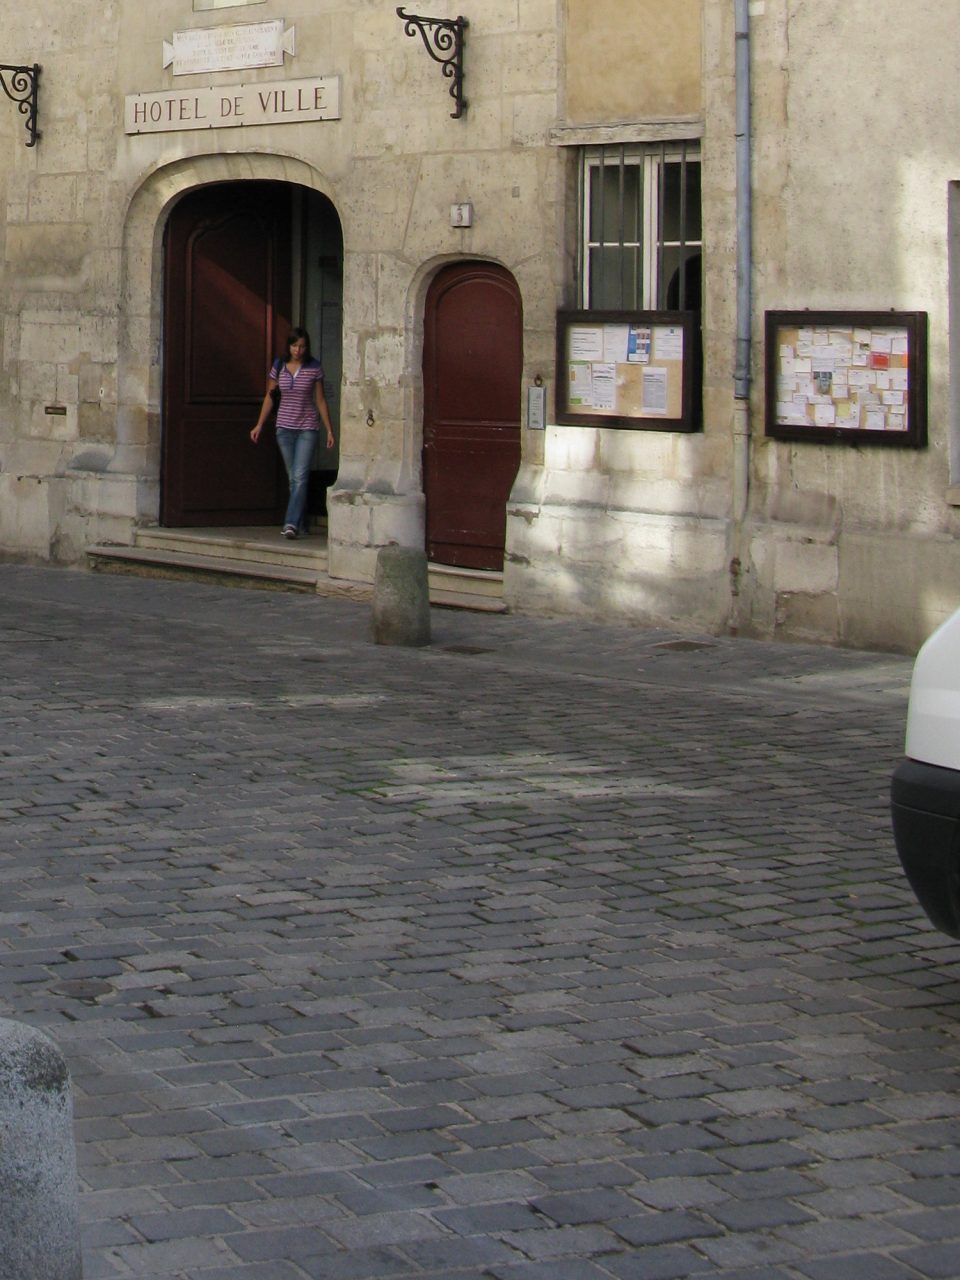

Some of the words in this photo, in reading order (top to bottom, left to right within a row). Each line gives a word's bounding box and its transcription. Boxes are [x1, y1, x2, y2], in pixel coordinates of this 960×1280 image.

[134, 98, 206, 123] HOTEL
[220, 97, 244, 117] DE
[258, 87, 327, 113] VILLE
